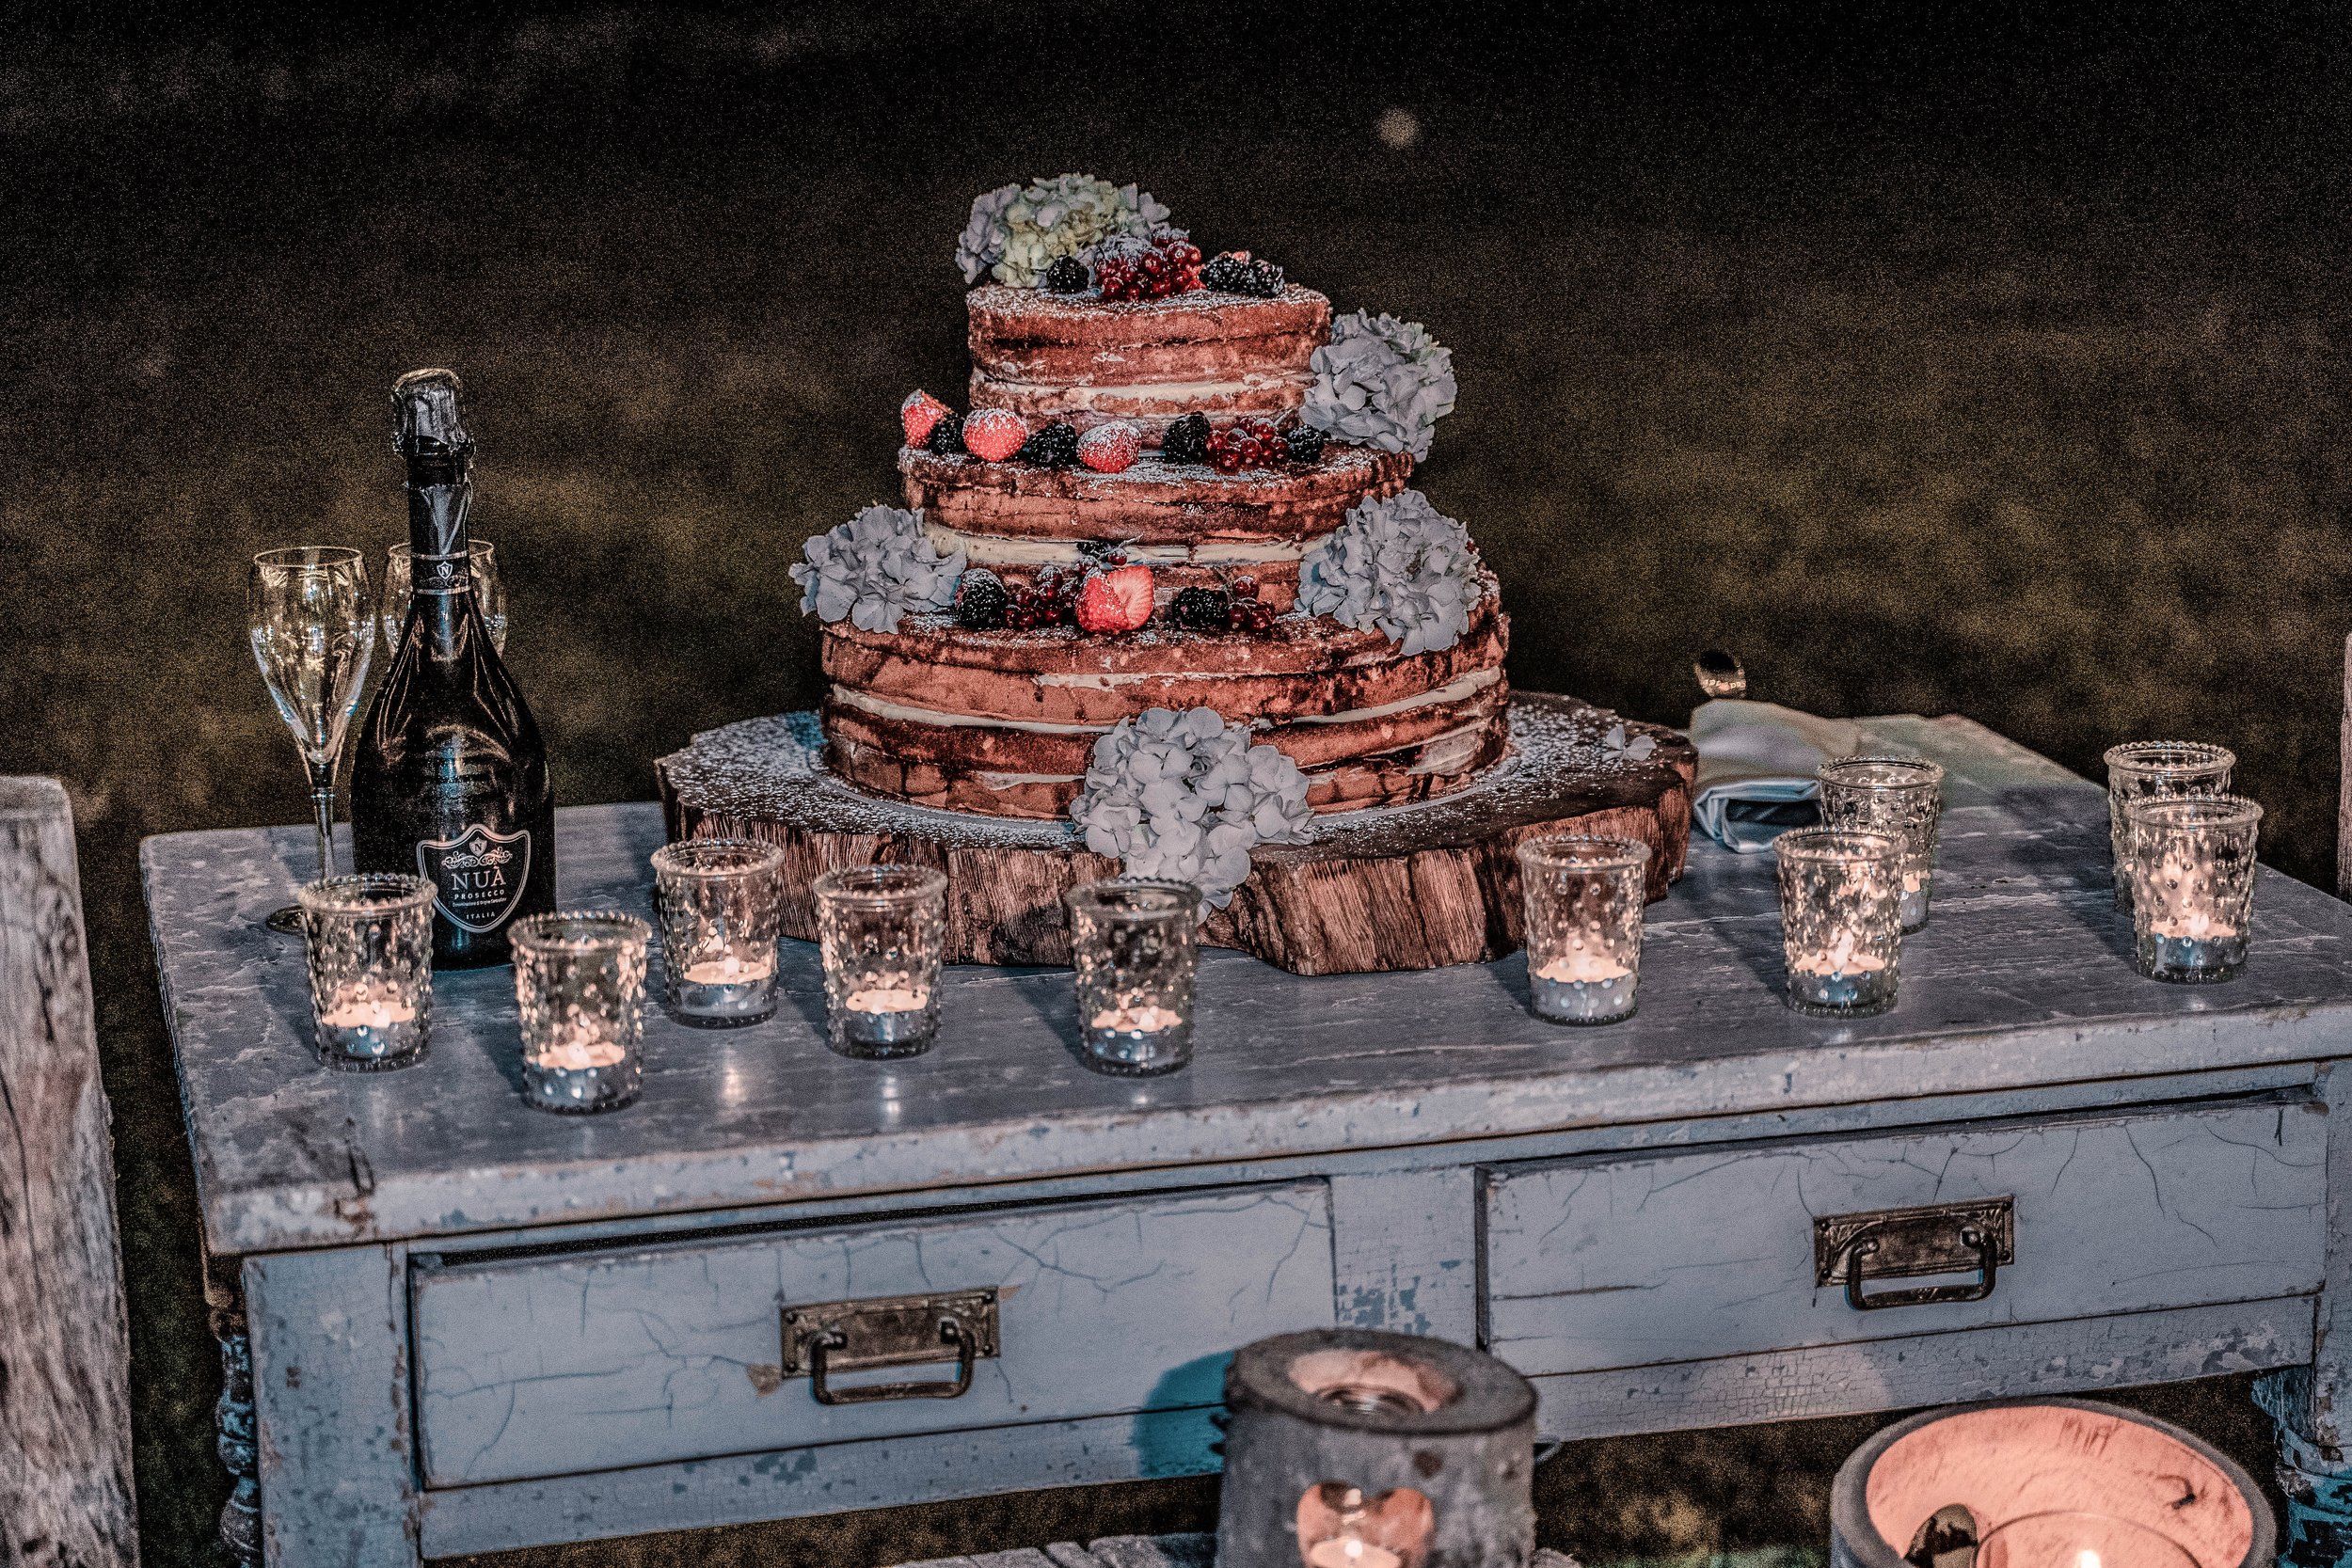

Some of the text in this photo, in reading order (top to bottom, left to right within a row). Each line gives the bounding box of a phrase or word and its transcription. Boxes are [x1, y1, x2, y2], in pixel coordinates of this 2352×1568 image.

[441, 566, 449, 575] N
[474, 843, 482, 851] N
[455, 889, 504, 900] PROSECCO
